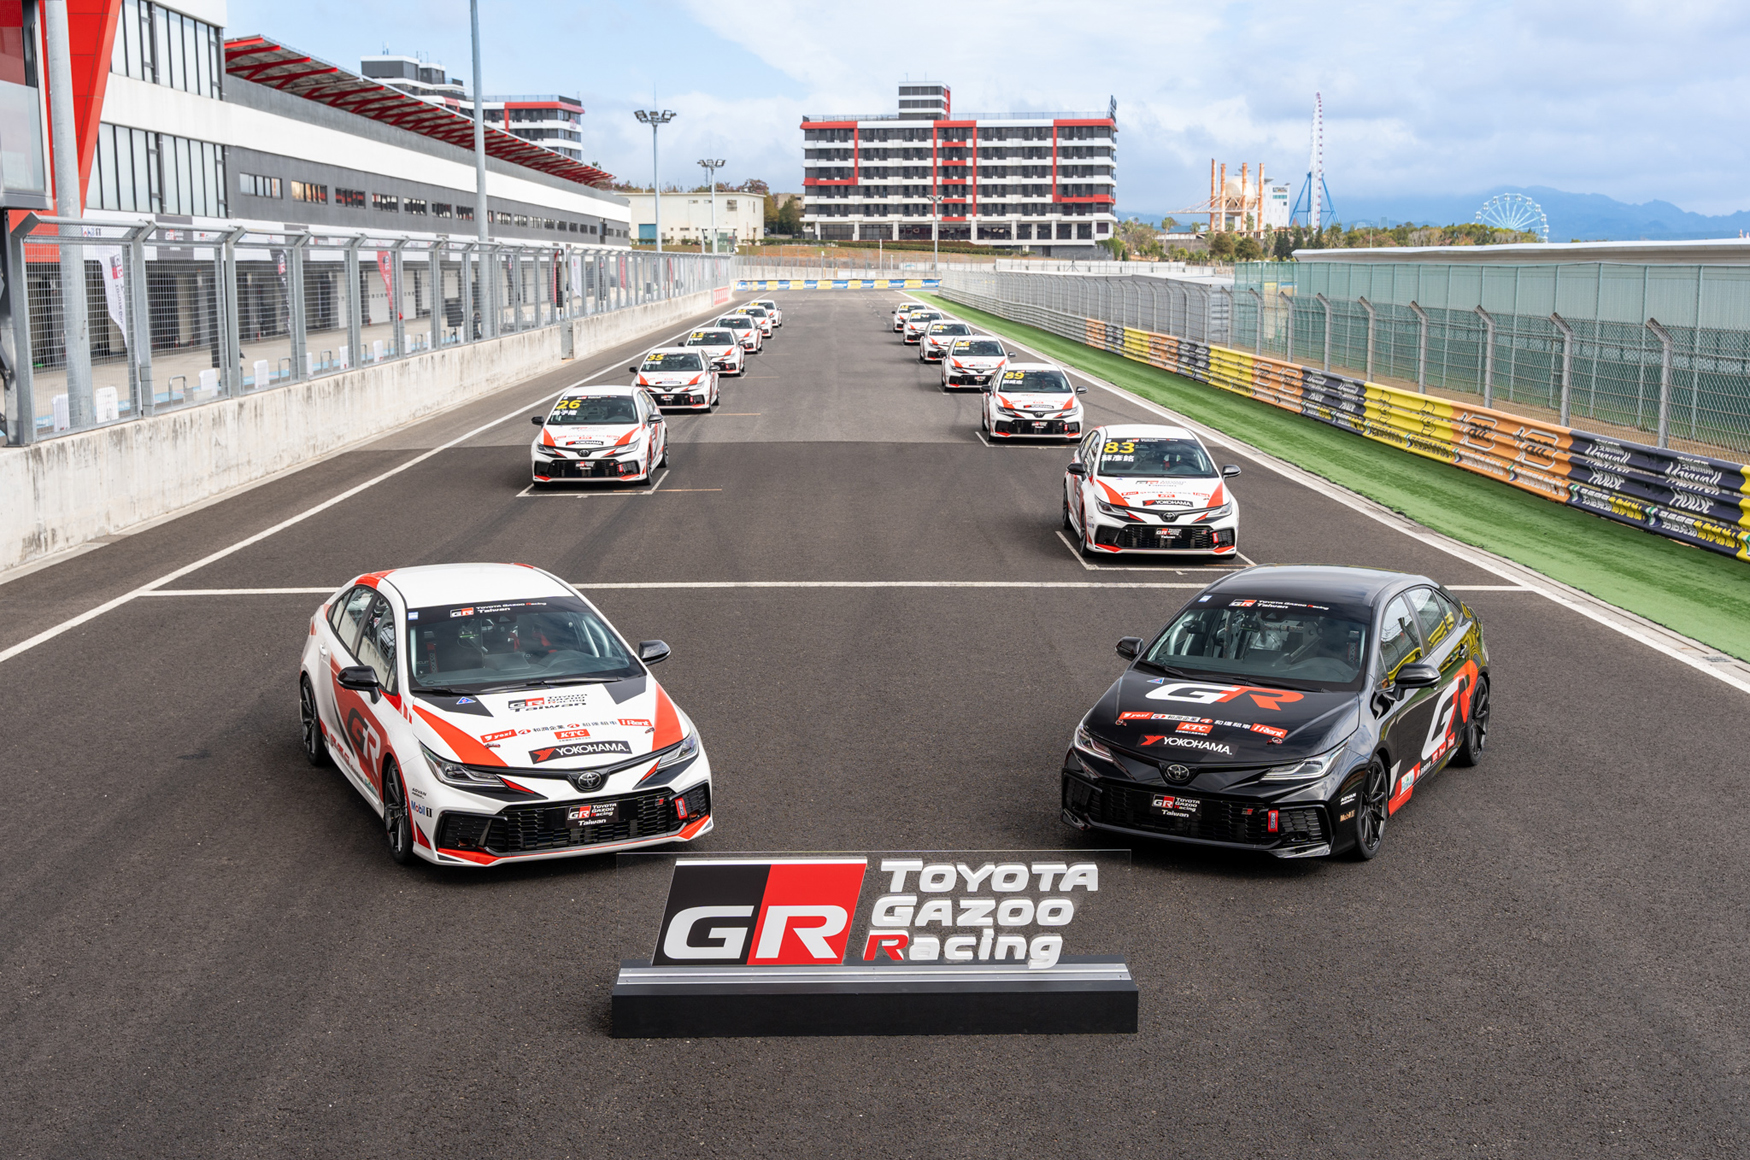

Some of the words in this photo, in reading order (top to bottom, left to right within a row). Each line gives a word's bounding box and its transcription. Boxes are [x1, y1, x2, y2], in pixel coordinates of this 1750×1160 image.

[1004, 371, 1025, 380] 89
[556, 399, 582, 409] 26
[1104, 441, 1135, 454] 83
[1229, 599, 1256, 607] GR
[450, 608, 474, 618] GR
[1145, 683, 1305, 711] GR
[508, 698, 545, 709] GR
[1421, 660, 1478, 761] GR
[1181, 723, 1209, 731] KTC
[561, 730, 586, 738] KTC
[347, 707, 381, 778] GR
[1163, 736, 1232, 755] YOKOHAMA
[555, 743, 627, 756] YOKOHAMA
[1152, 798, 1174, 809] GR
[1176, 797, 1201, 805] TOYOTA
[411, 800, 426, 816] Mobil
[1161, 809, 1189, 818] Taiwan
[568, 809, 590, 820] GR
[578, 818, 607, 826] Taiwan
[881, 858, 1099, 893] TOYOTA
[871, 894, 1075, 928] GAZOO
[663, 905, 848, 960] GR
[863, 928, 1064, 970] Racing
